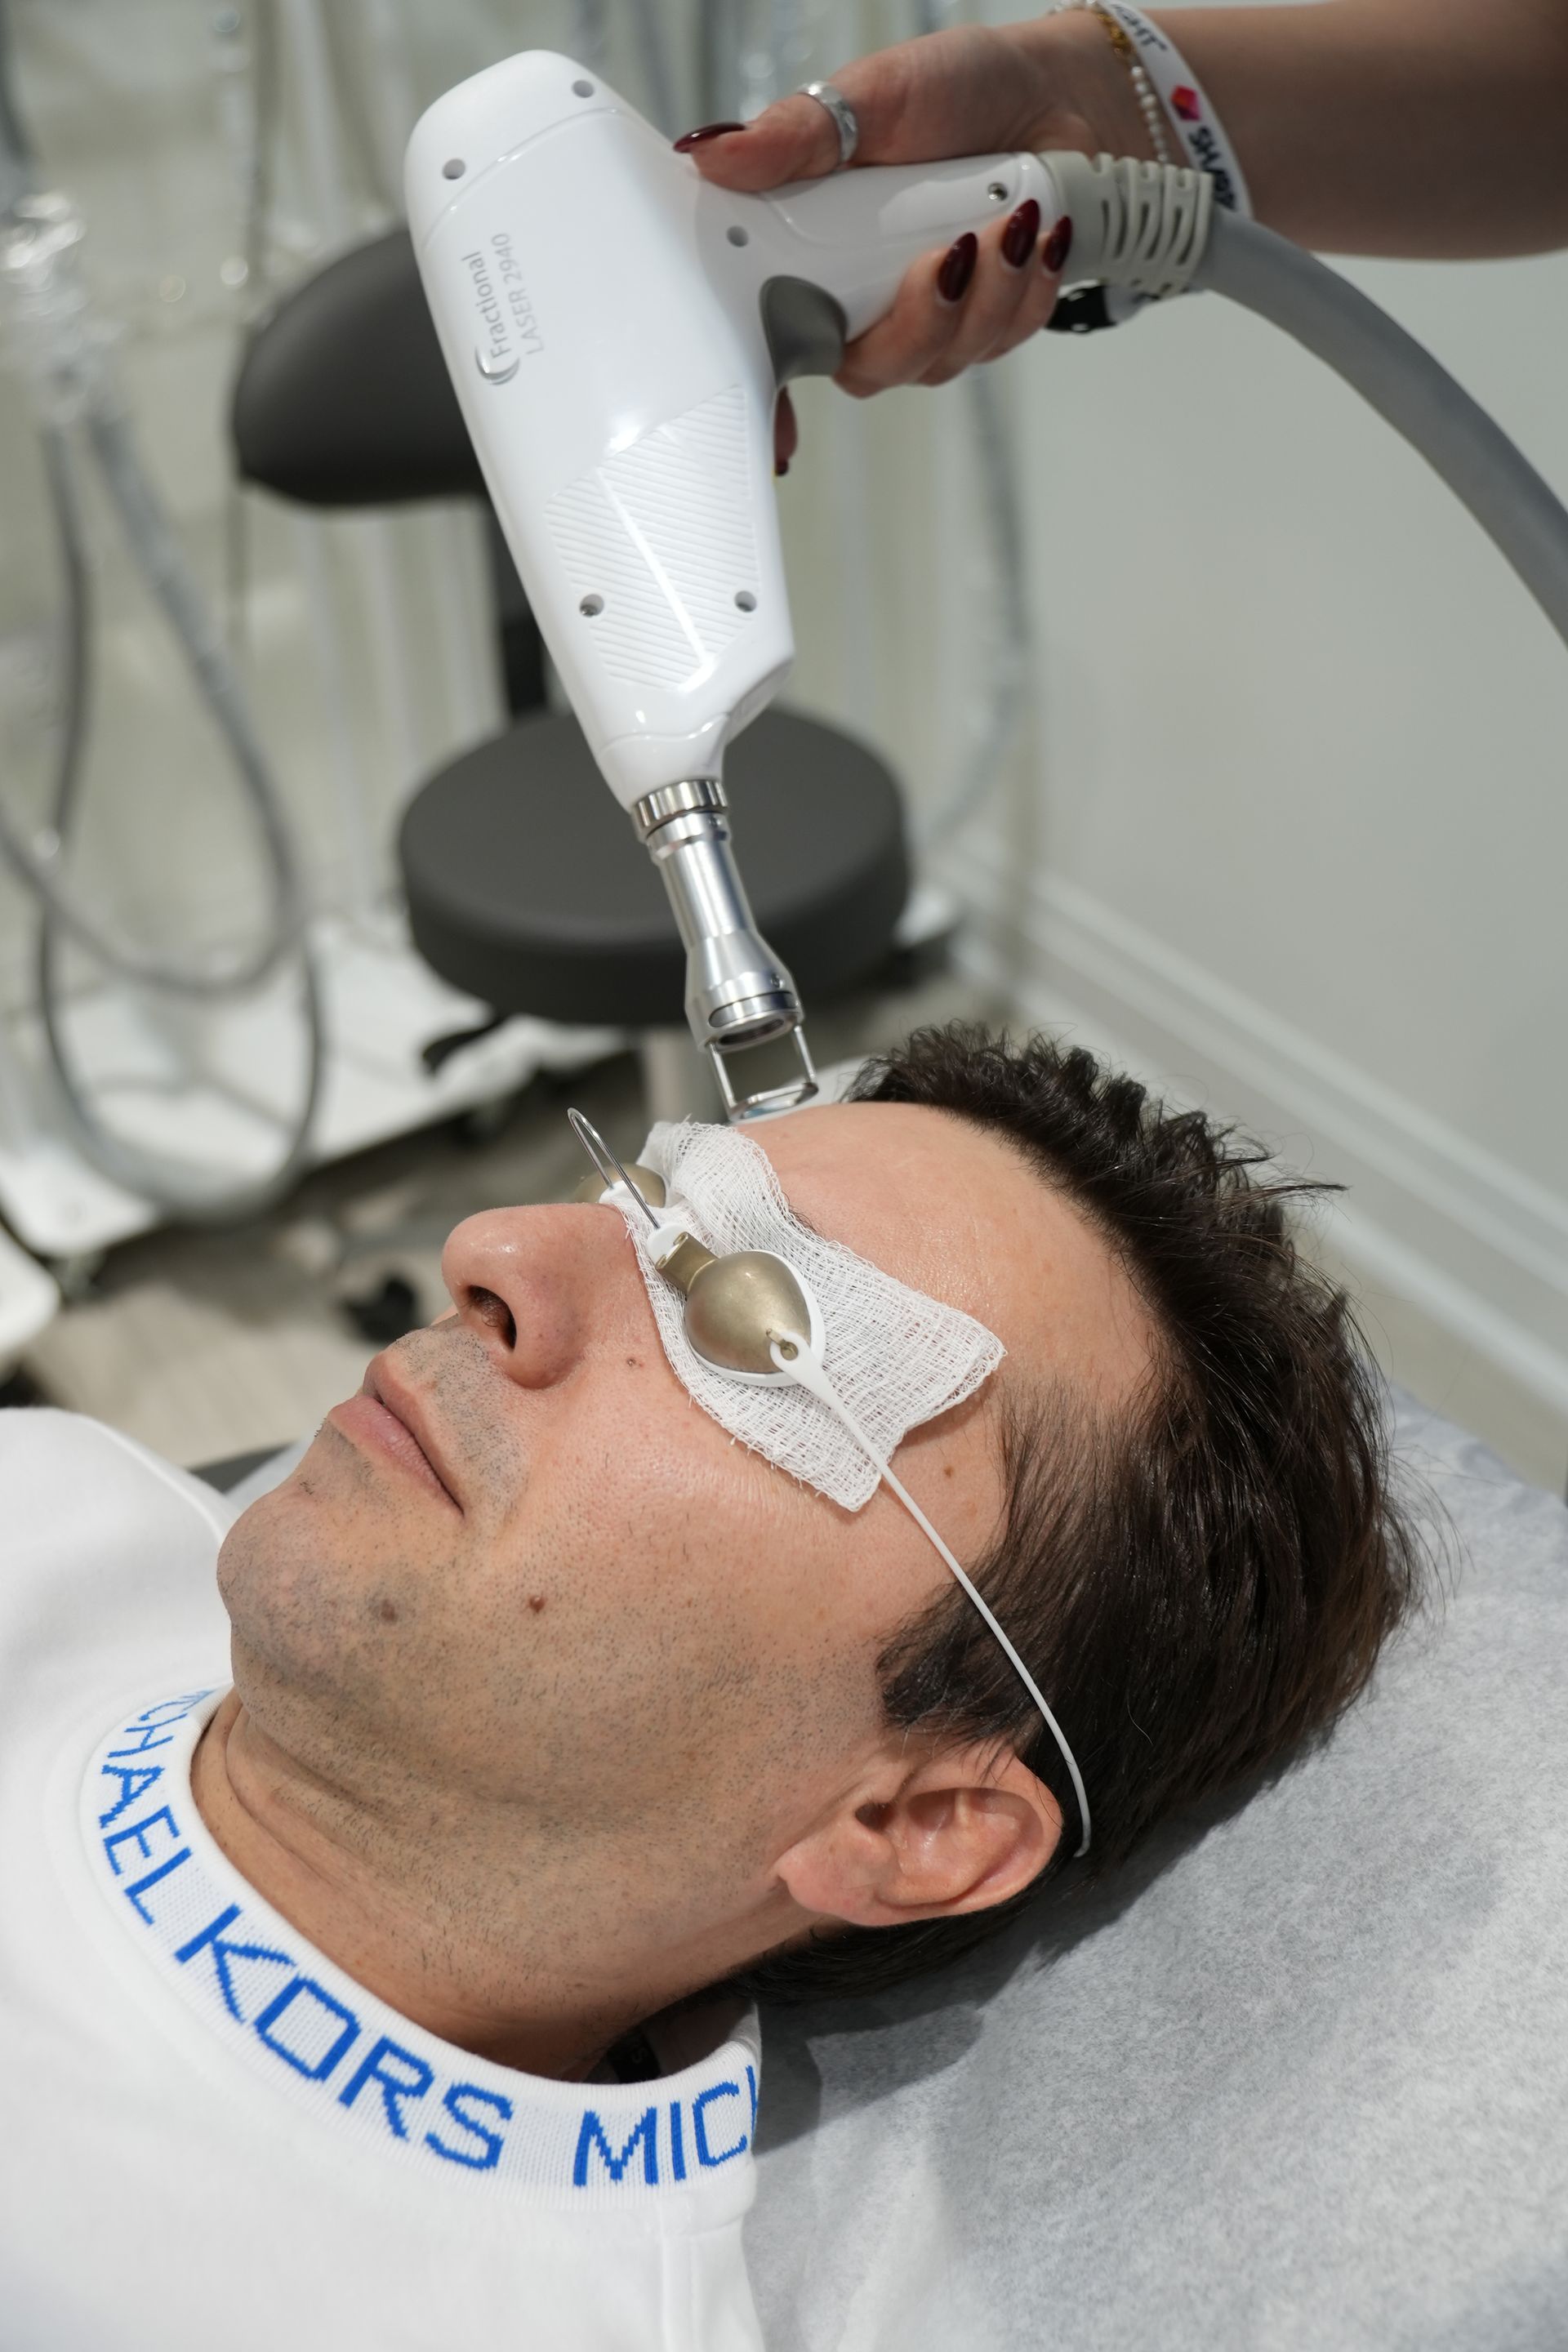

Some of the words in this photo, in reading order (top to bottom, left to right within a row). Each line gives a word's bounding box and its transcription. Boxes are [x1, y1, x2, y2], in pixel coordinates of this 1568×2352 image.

[491, 233, 523, 284] 2940
[461, 251, 511, 358] Fractional
[508, 287, 543, 354] LASER
[173, 1903, 514, 2172] KORS
